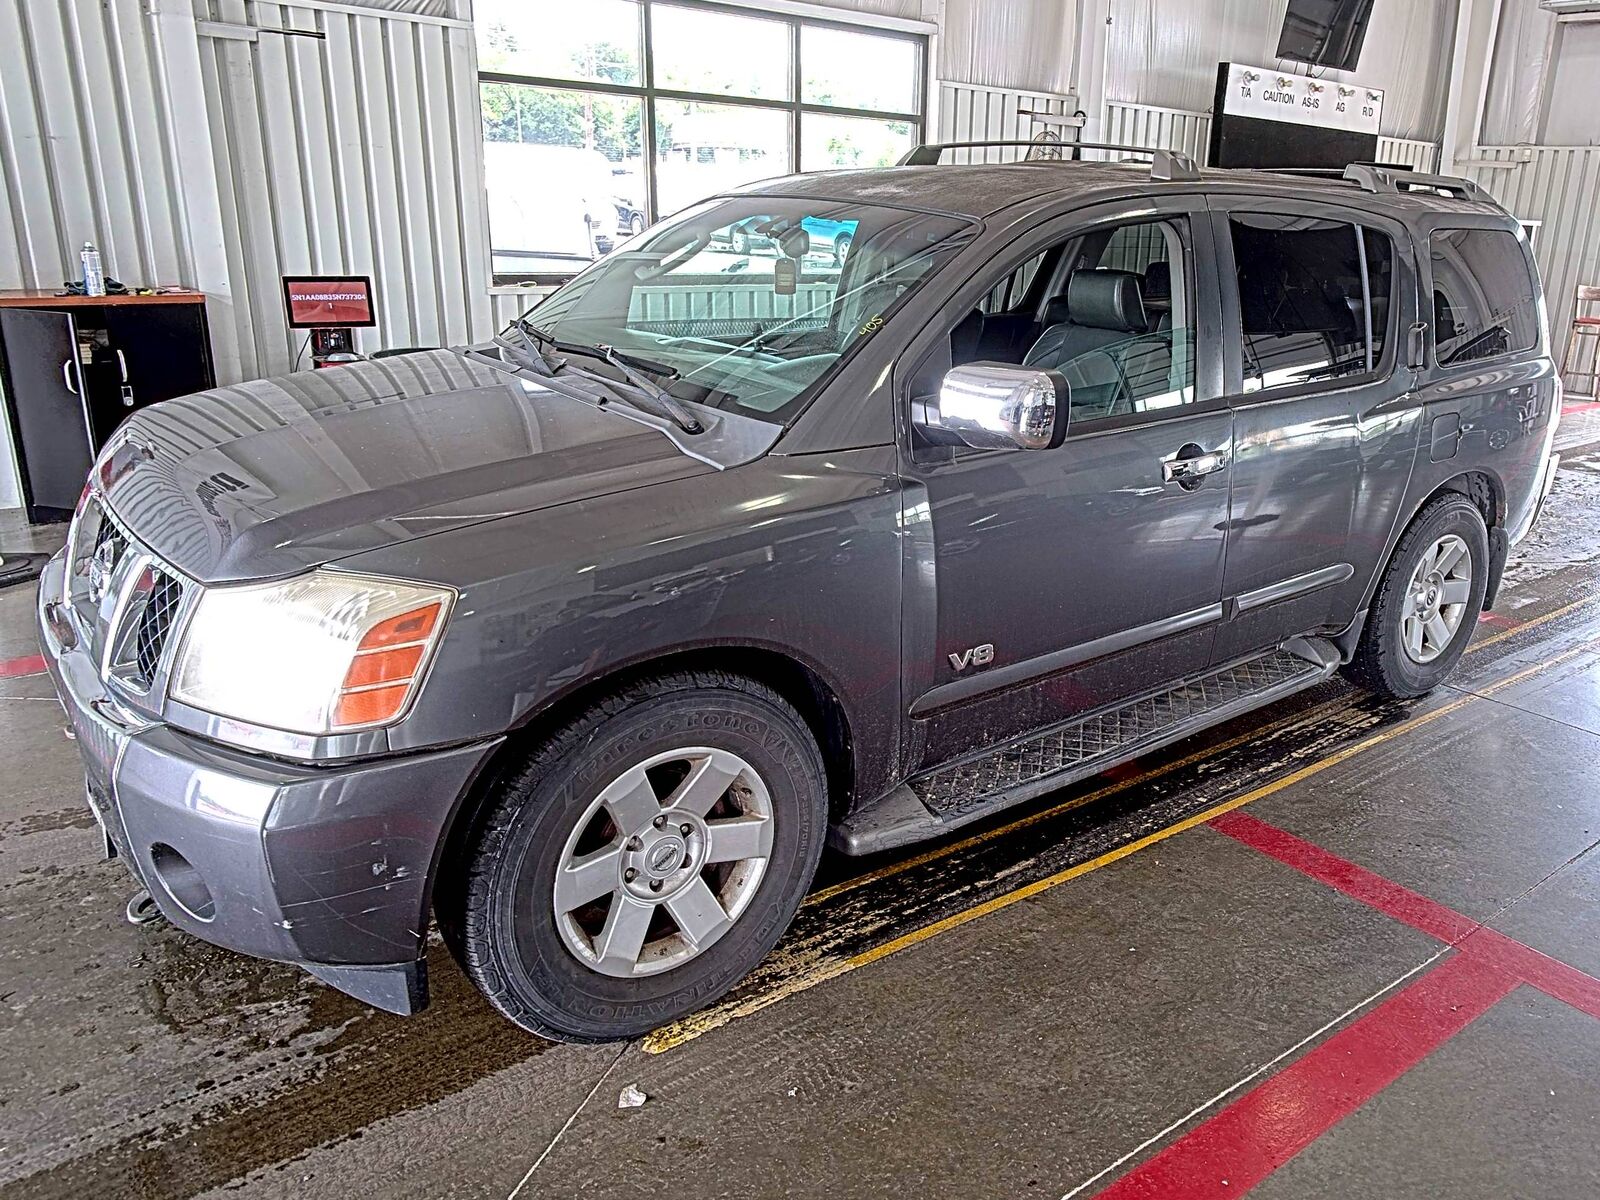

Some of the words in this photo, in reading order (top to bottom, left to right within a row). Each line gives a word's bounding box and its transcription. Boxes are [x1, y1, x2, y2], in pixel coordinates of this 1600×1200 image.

[1241, 86, 1252, 98] T/A
[1263, 90, 1295, 105] CAUTION
[1302, 97, 1320, 109] AS-IS
[1335, 102, 1346, 112] AG
[1362, 106, 1374, 117] R/D
[948, 643, 994, 672] V8
[655, 847, 676, 869] NISSAN
